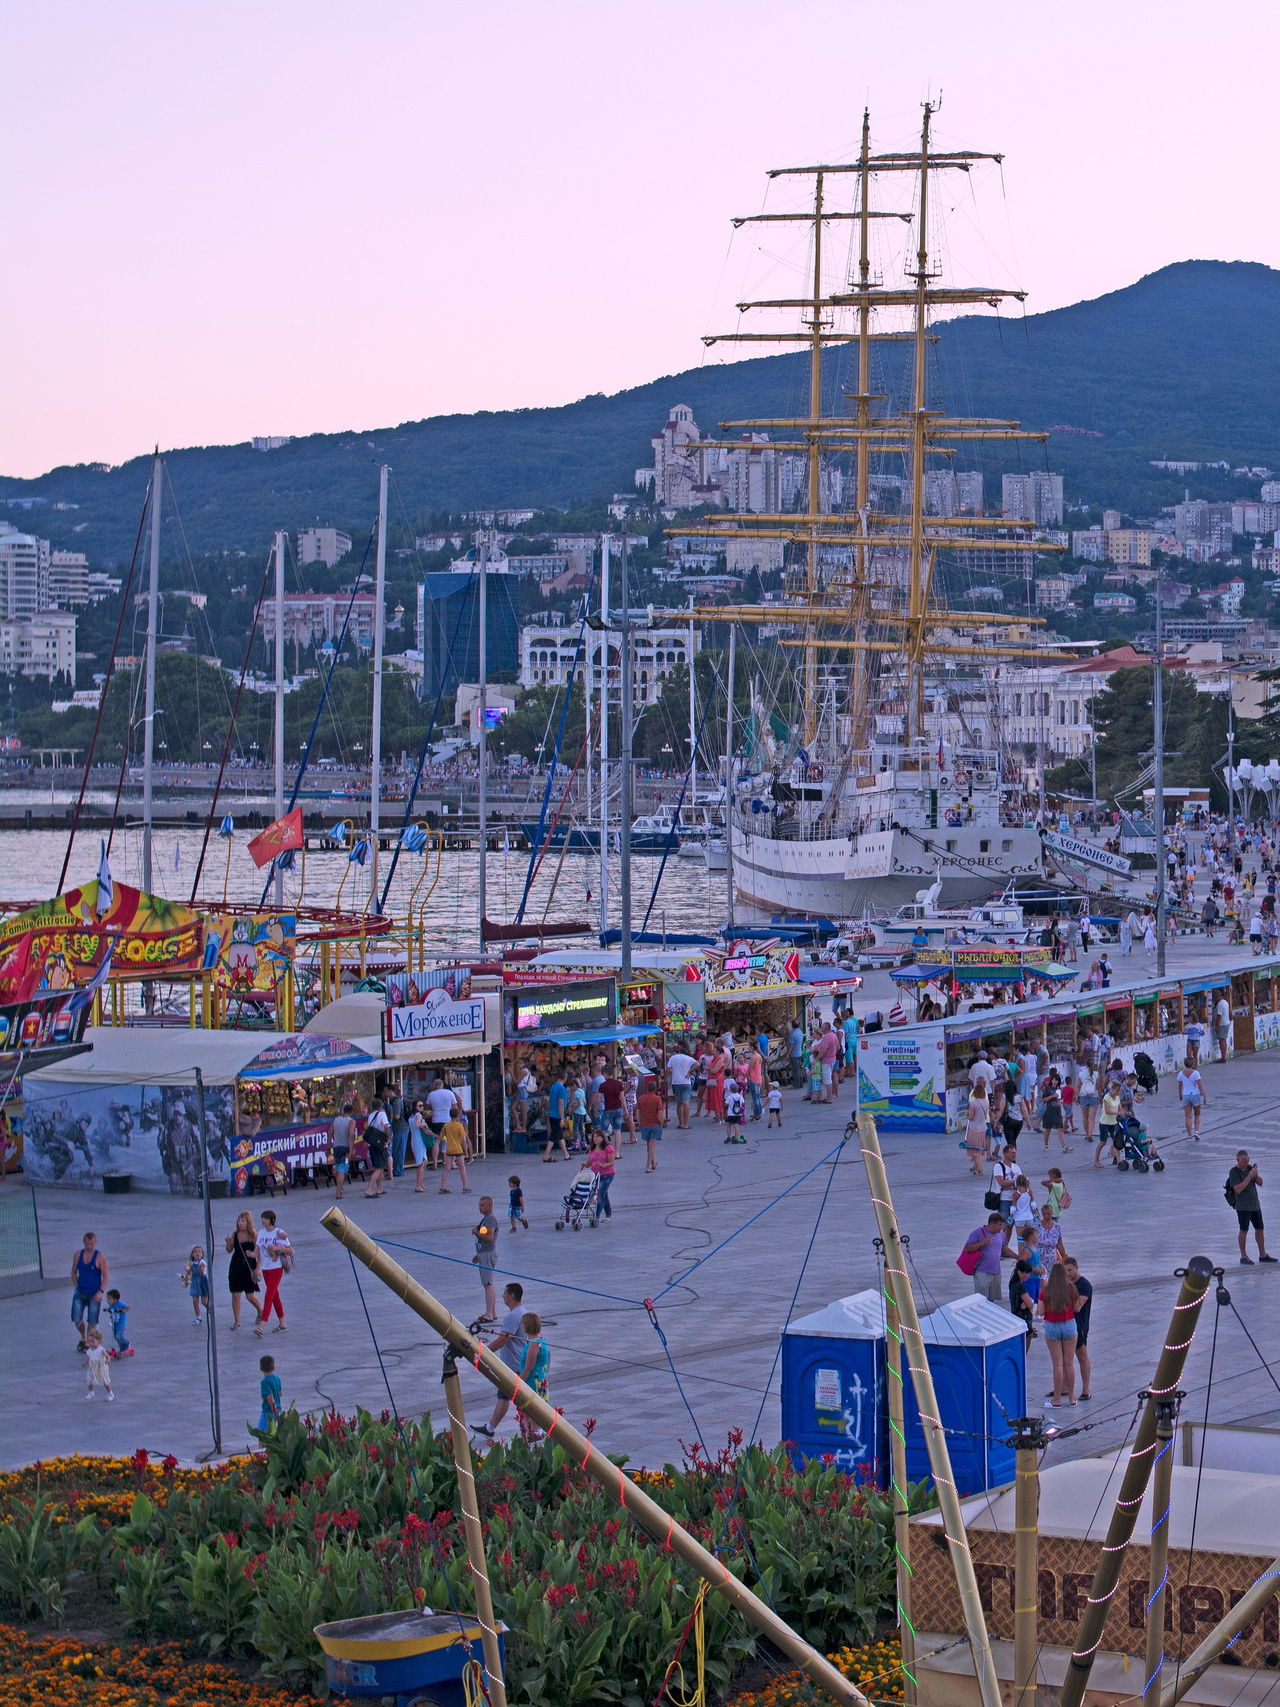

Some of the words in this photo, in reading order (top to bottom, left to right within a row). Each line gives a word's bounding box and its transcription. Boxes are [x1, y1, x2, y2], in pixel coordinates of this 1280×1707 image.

[932, 856, 1003, 867] ХЕРСОНЕС
[1058, 836, 1114, 865] ХЕРСОНЕС
[3, 919, 35, 939] Familie
[36, 915, 76, 928] Attractie
[883, 1046, 921, 1055] КНИЖНЫЕ
[253, 1134, 297, 1157] детский
[287, 1151, 327, 1184] ТИР
